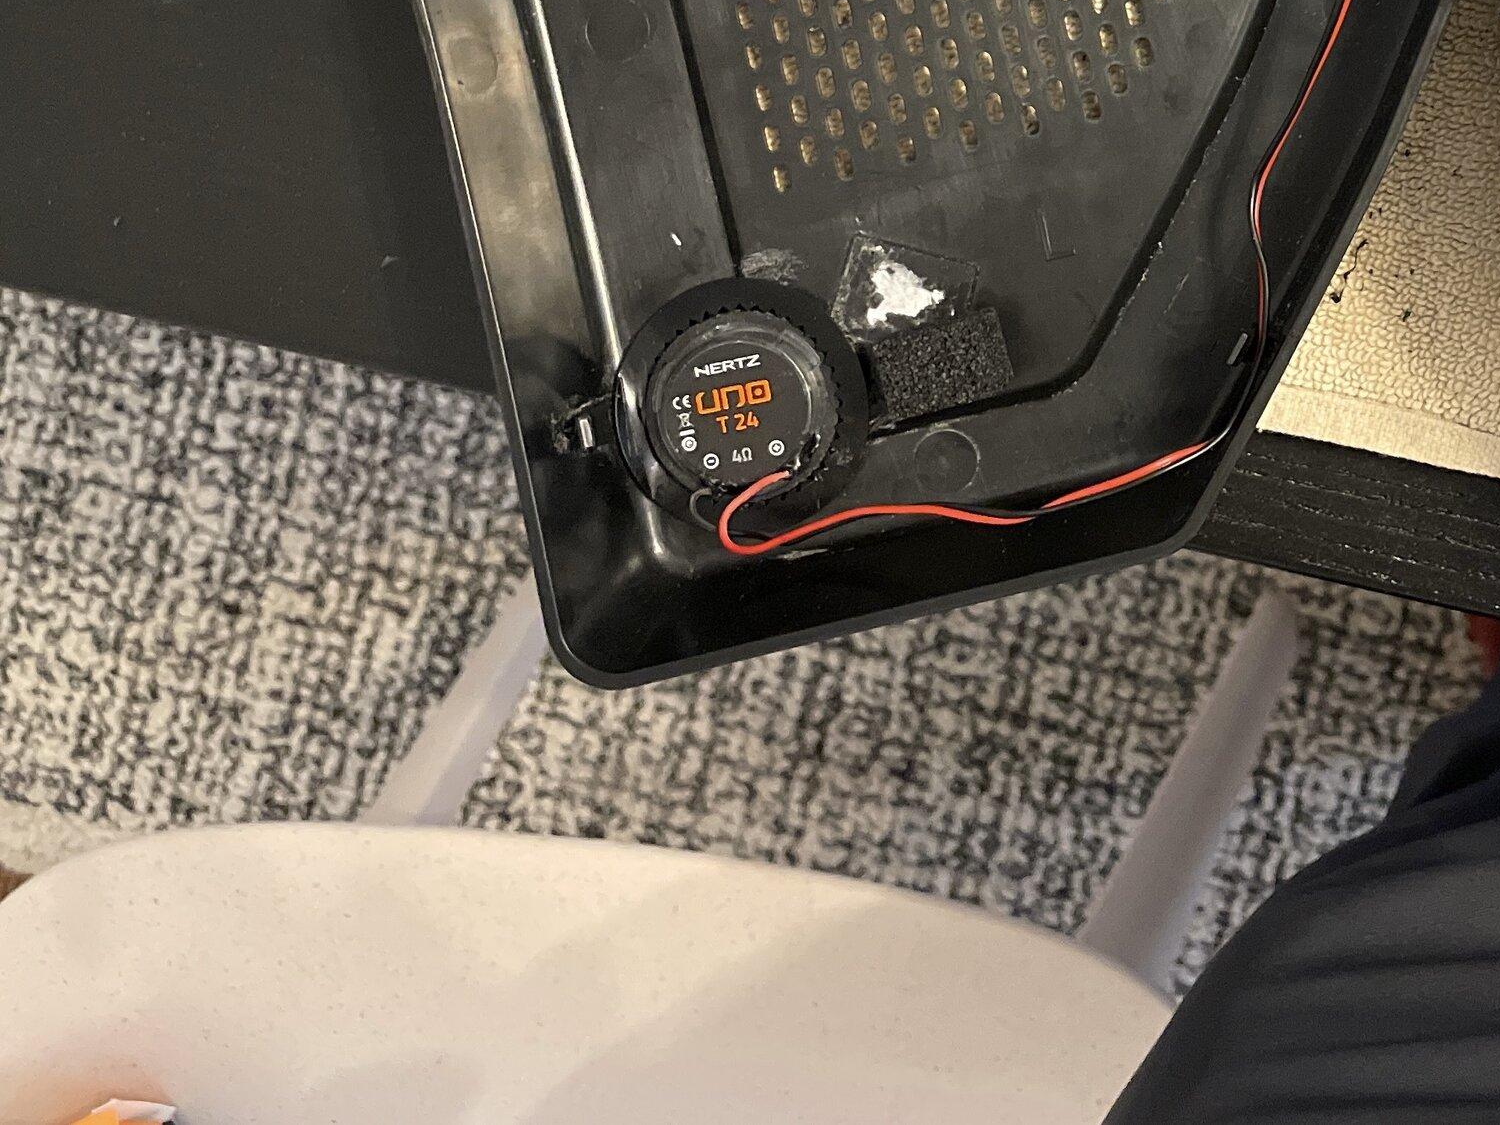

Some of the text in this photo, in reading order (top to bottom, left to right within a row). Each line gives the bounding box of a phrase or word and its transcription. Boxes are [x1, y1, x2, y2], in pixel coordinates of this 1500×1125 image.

[693, 354, 762, 378] HERTZ
[672, 394, 692, 410] CE
[716, 411, 760, 433] T 24
